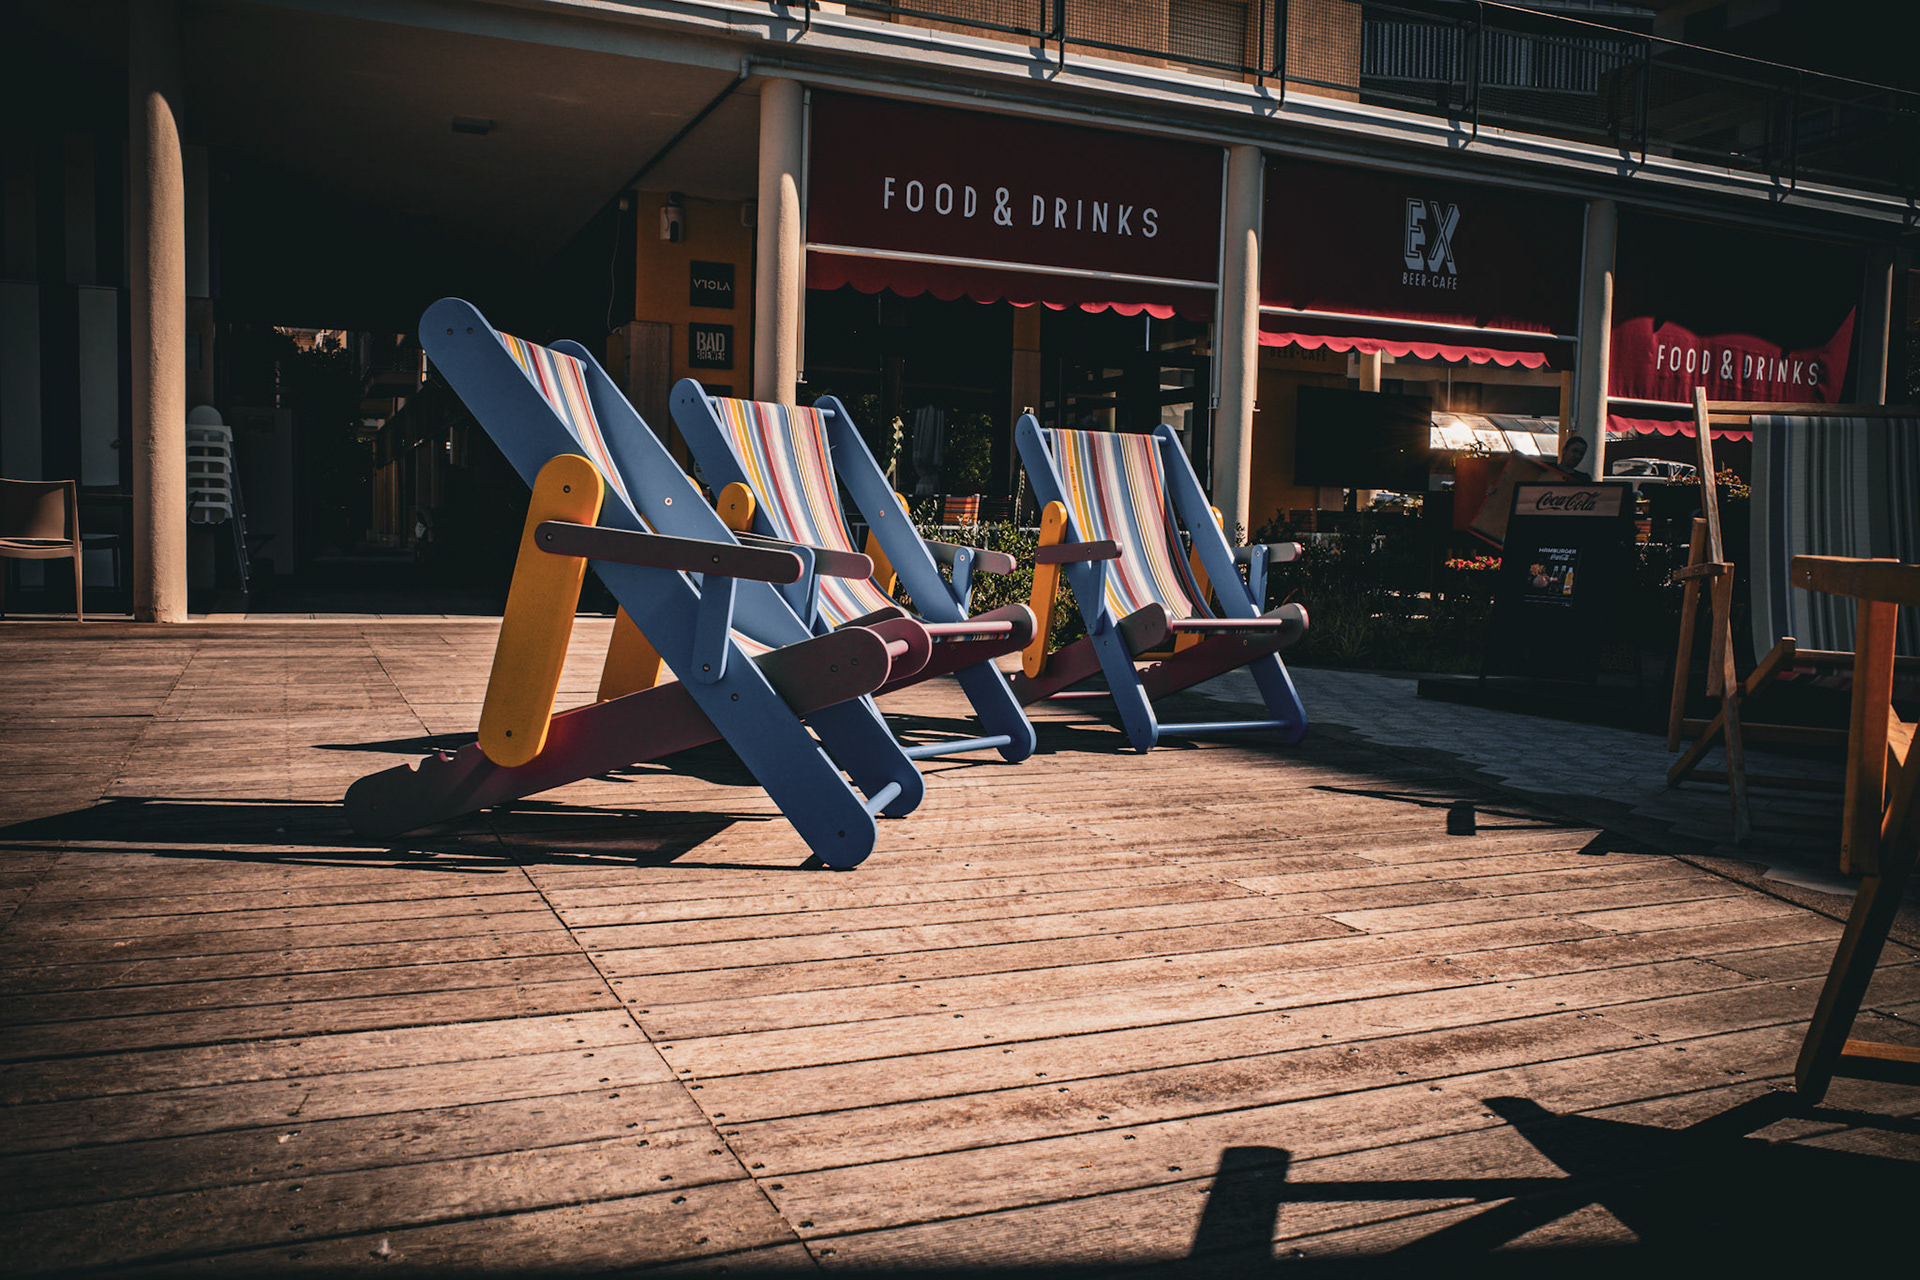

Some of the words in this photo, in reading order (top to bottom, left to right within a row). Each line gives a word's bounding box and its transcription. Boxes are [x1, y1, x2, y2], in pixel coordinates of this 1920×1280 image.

[883, 176, 977, 219] FOOD
[993, 186, 1013, 227] &
[1031, 194, 1159, 238] DRINKS
[1404, 197, 1460, 275] EX
[693, 278, 731, 292] VIOLA
[696, 331, 726, 352] BAD
[696, 350, 726, 361] BREWER
[1656, 344, 1711, 375] FOOD
[1720, 349, 1733, 380] &
[1743, 354, 1820, 387] DRINKS
[1538, 547, 1577, 555] HAMBURGER
